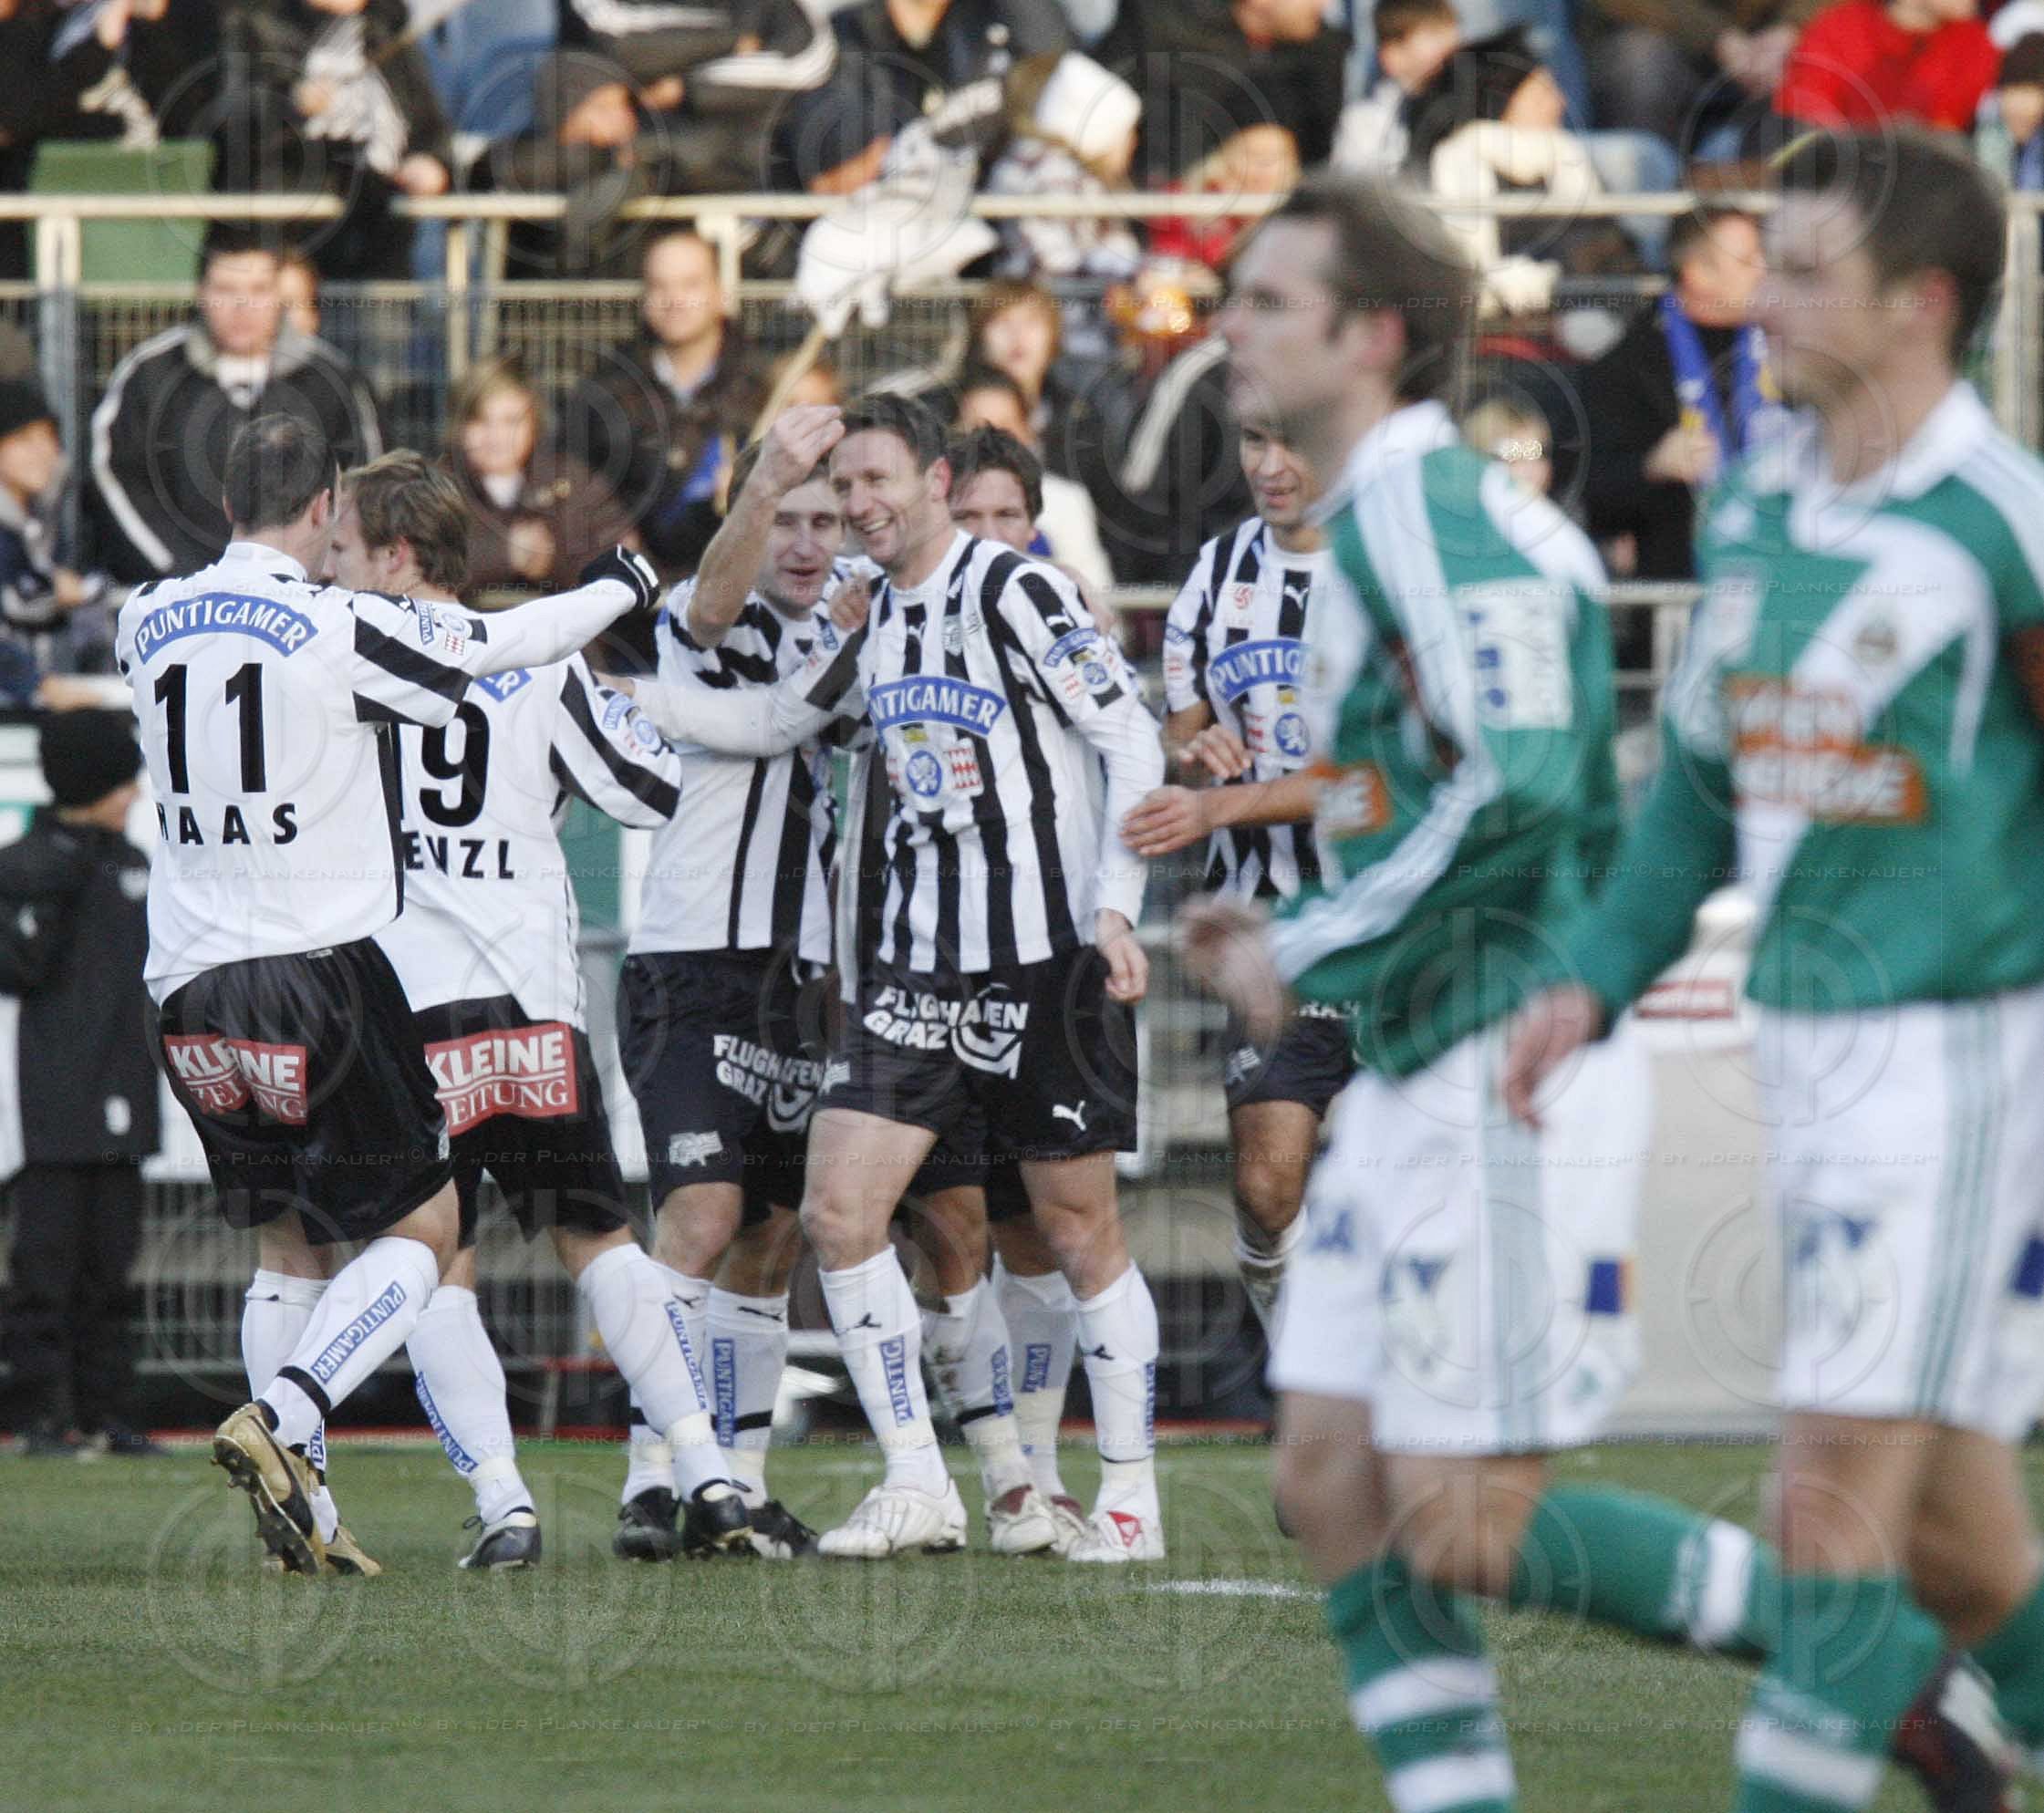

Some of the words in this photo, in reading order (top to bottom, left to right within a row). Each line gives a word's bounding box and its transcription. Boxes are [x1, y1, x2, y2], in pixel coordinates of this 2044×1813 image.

[137, 599, 307, 656] PUNTIGAMER
[154, 663, 266, 793] 11
[419, 700, 490, 827] 9
[863, 1009, 949, 1050] GRAZ
[425, 1031, 566, 1089] KLEINE
[442, 1079, 568, 1125] EITUNG
[314, 1283, 405, 1382] PUNTIGAMER
